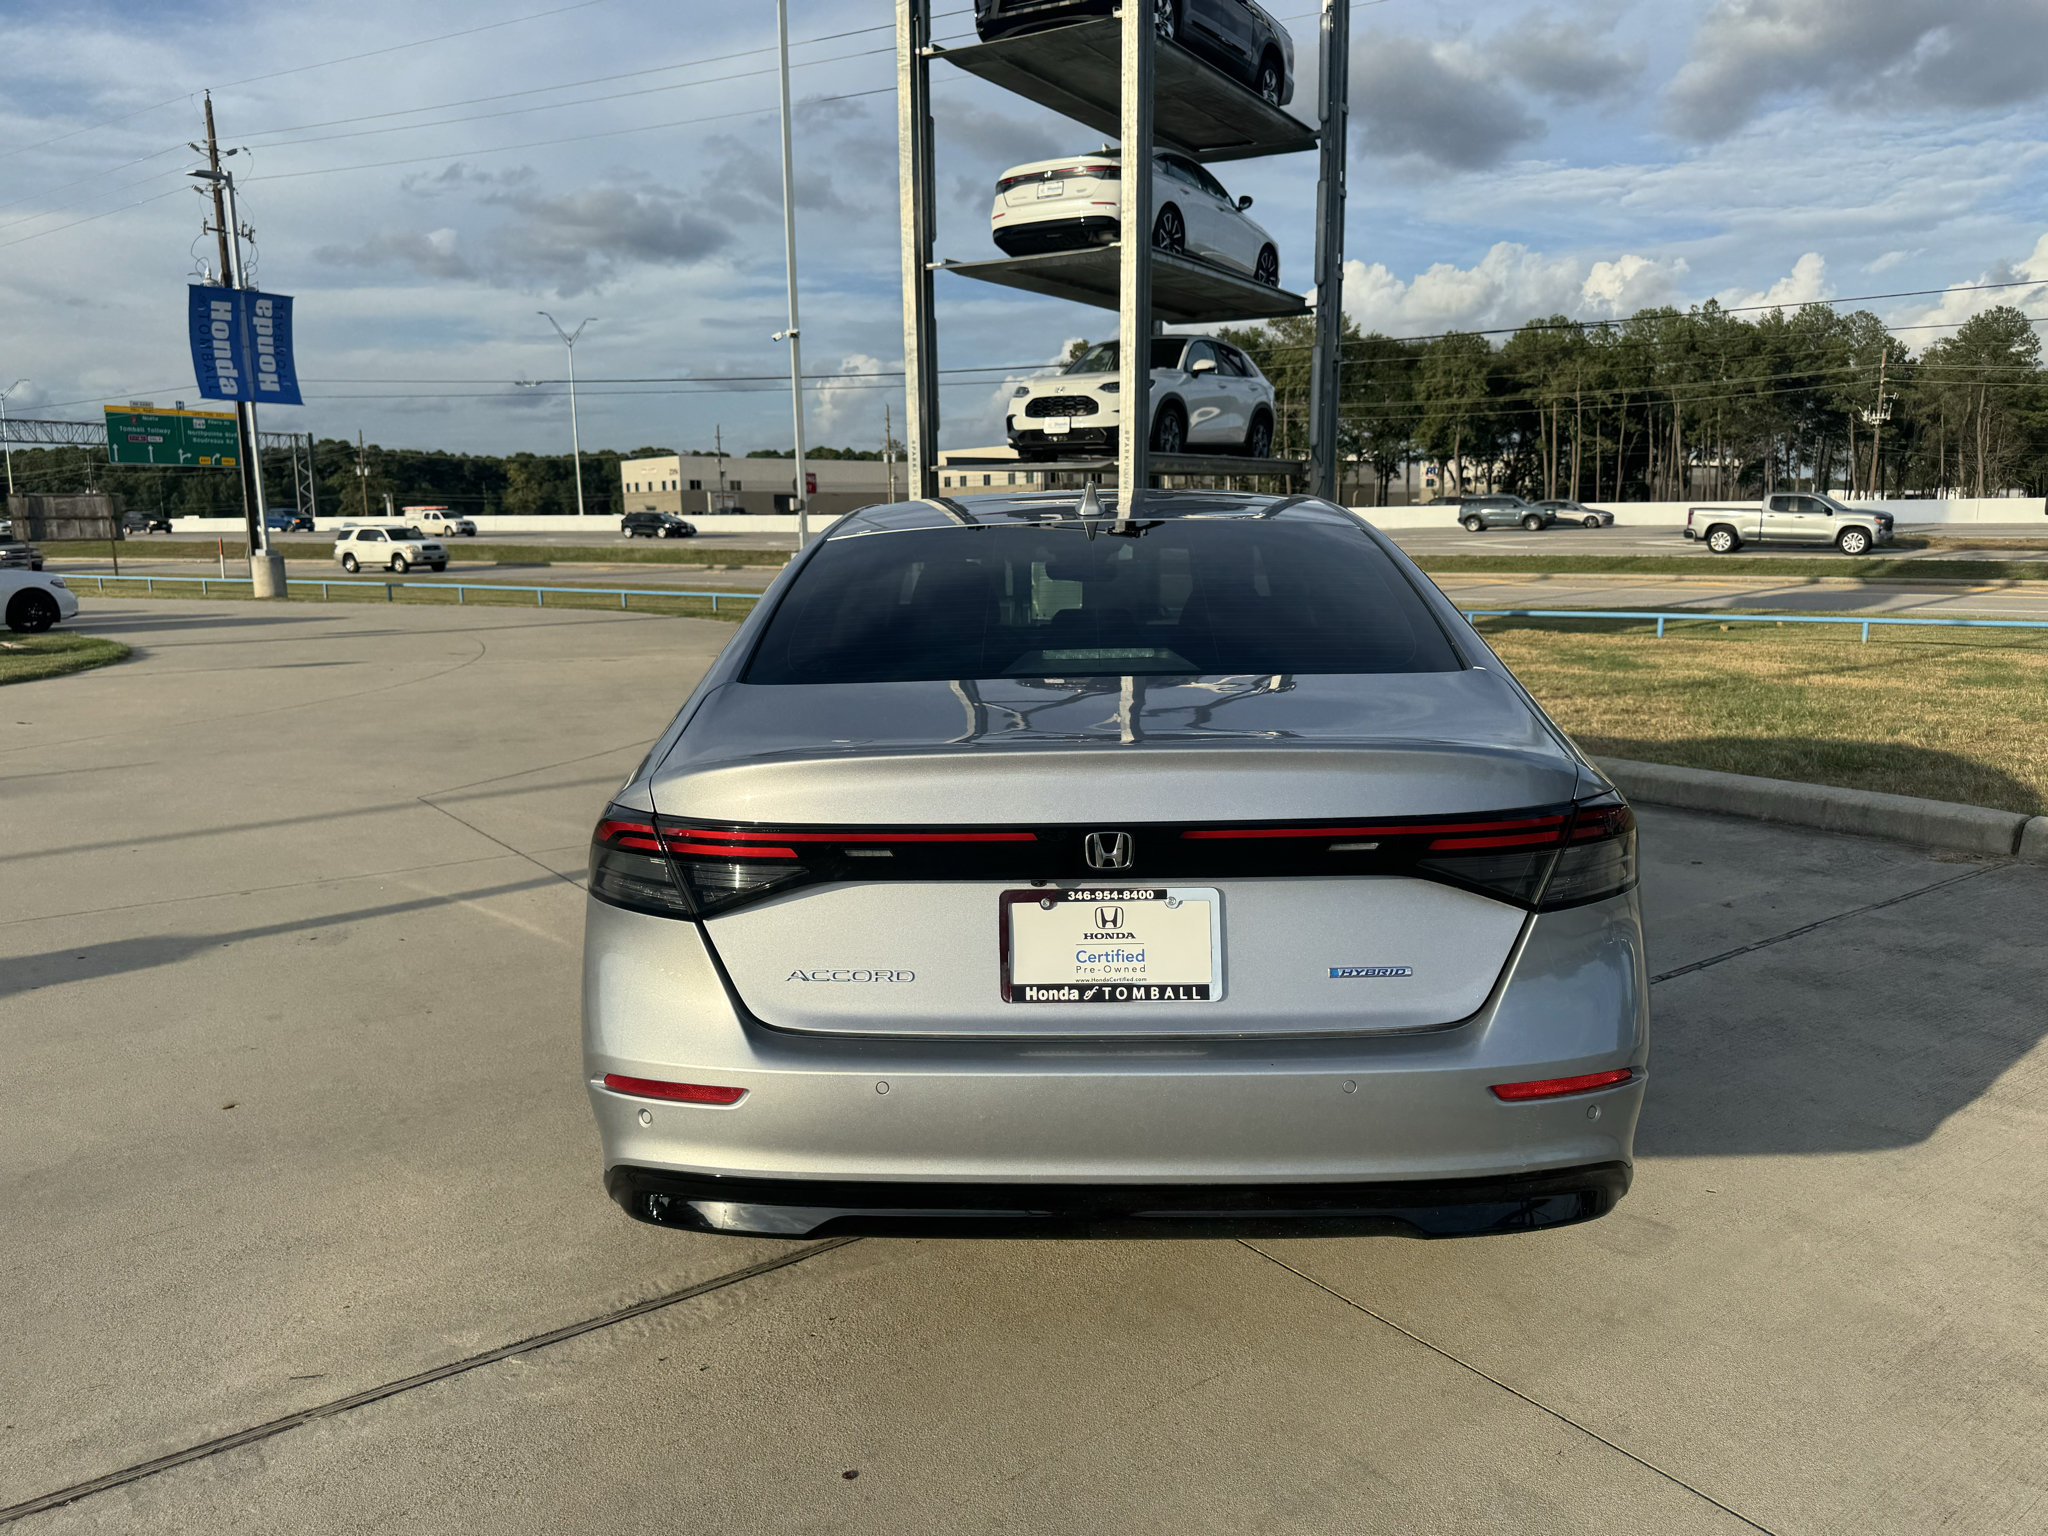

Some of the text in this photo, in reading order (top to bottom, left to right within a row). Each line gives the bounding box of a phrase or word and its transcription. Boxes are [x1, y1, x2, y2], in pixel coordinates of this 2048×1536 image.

[210, 300, 238, 395] Honda
[253, 299, 280, 391] Honda
[198, 314, 220, 392] TOMBALL
[147, 427, 171, 435] Tollway
[1068, 890, 1154, 900] 346-954-8400
[1083, 932, 1136, 940] HONDA
[1076, 948, 1145, 964] Certified
[1076, 964, 1146, 974] Pre-Owned
[1340, 968, 1406, 976] HYBRID
[785, 970, 915, 982] ACCORD
[1025, 986, 1201, 1000] Honda of TOMBALL
